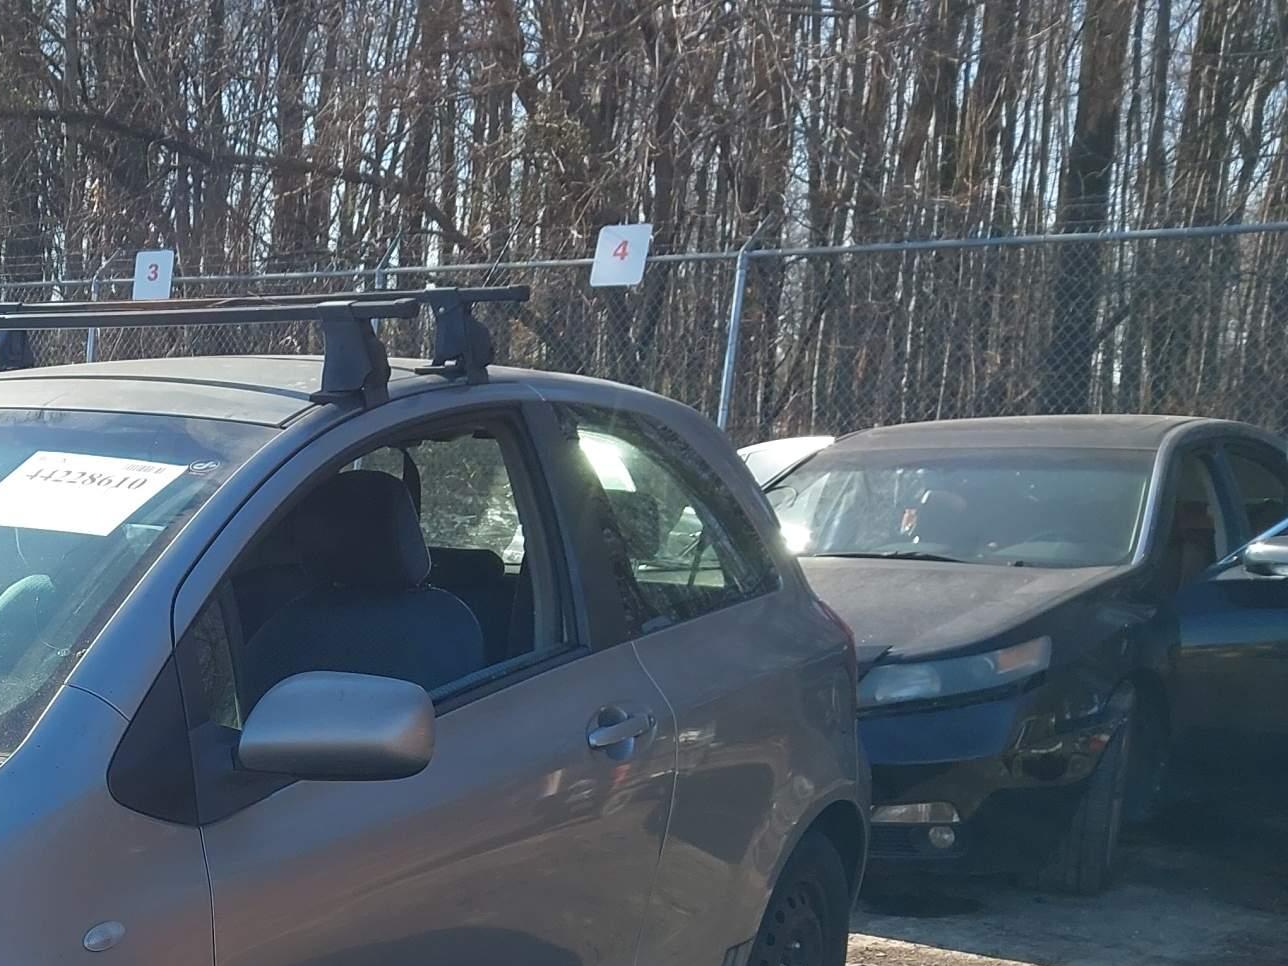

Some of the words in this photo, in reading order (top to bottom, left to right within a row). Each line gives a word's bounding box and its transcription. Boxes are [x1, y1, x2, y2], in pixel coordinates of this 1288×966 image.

[613, 239, 629, 261] 4
[147, 263, 159, 282] 3
[25, 468, 148, 490] 44228610
